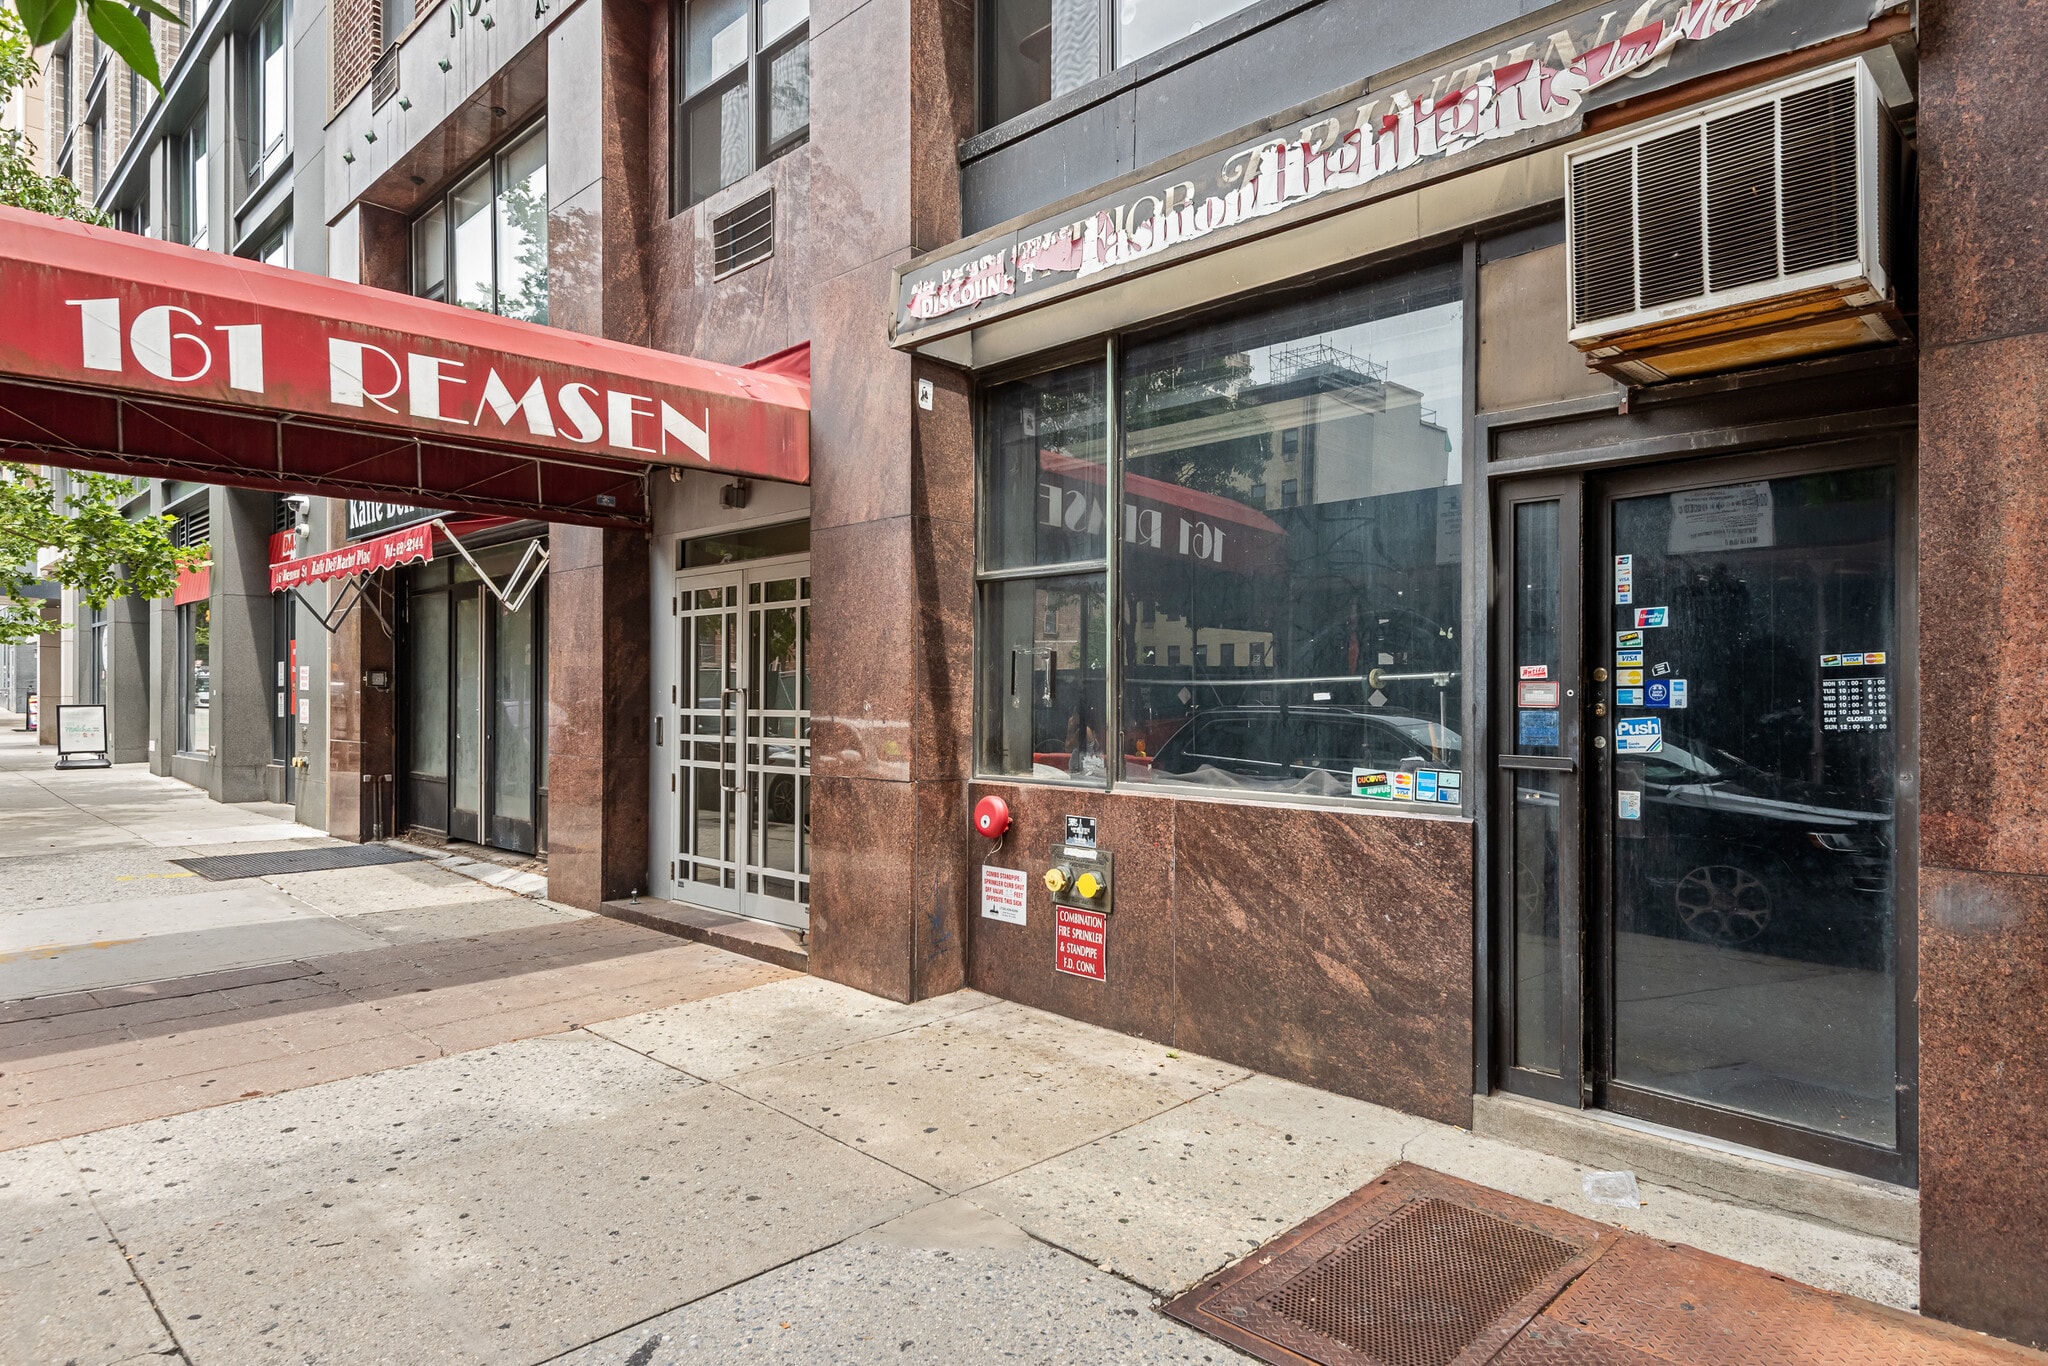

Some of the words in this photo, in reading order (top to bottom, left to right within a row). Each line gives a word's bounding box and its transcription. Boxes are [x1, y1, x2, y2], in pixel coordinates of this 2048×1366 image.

[65, 297, 264, 393] 161
[329, 337, 711, 462] REMSEN
[1618, 720, 1658, 735] Push
[1367, 785, 1391, 795] NOVUS
[984, 878, 1003, 886] SPRINKLER
[986, 870, 999, 878] COMBO
[1000, 873, 1020, 882] STANDPIPE
[986, 895, 1003, 903] OPPOSITE
[1060, 910, 1103, 929] COMBINATION
[1059, 925, 1070, 937] FIRE
[1072, 928, 1103, 945] SPRINKLER
[1060, 941, 1065, 952] &
[1067, 943, 1097, 959] STANDPIPE
[1064, 957, 1074, 970] F.D.
[1076, 960, 1097, 975] CONN.
